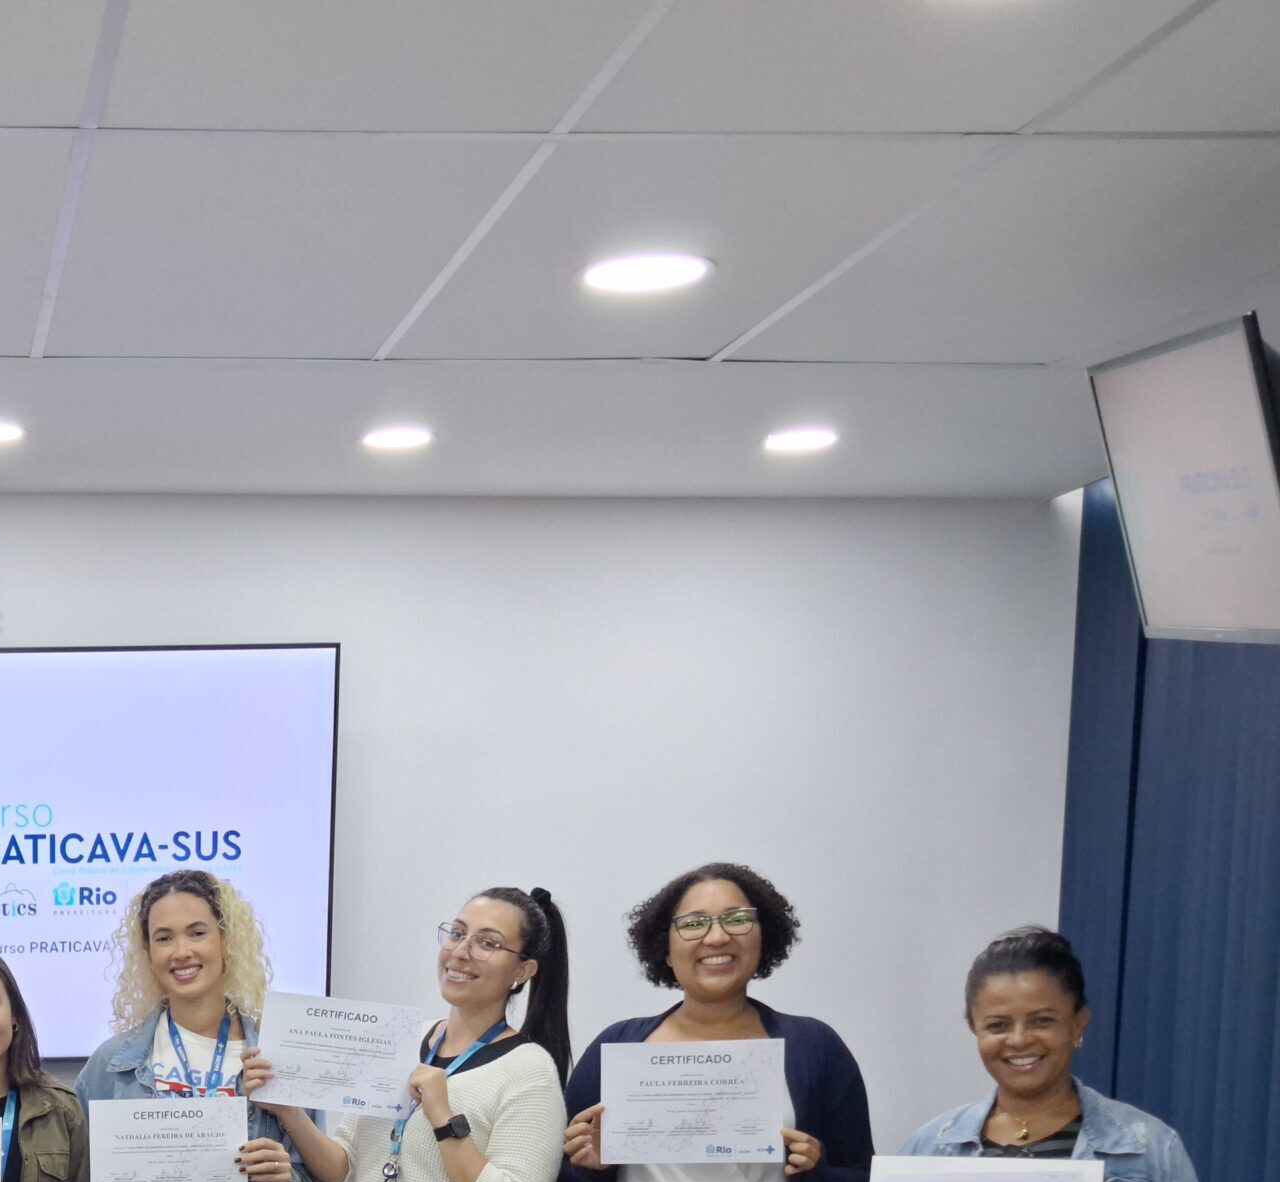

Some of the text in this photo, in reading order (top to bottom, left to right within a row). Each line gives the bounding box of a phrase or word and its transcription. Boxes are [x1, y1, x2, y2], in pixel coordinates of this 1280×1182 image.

[78, 886, 117, 906] Rio
[306, 1008, 378, 1024] CERTIFICADO
[650, 1054, 732, 1065] CERTIFICADO
[133, 1109, 204, 1120] CERTIFICADO
